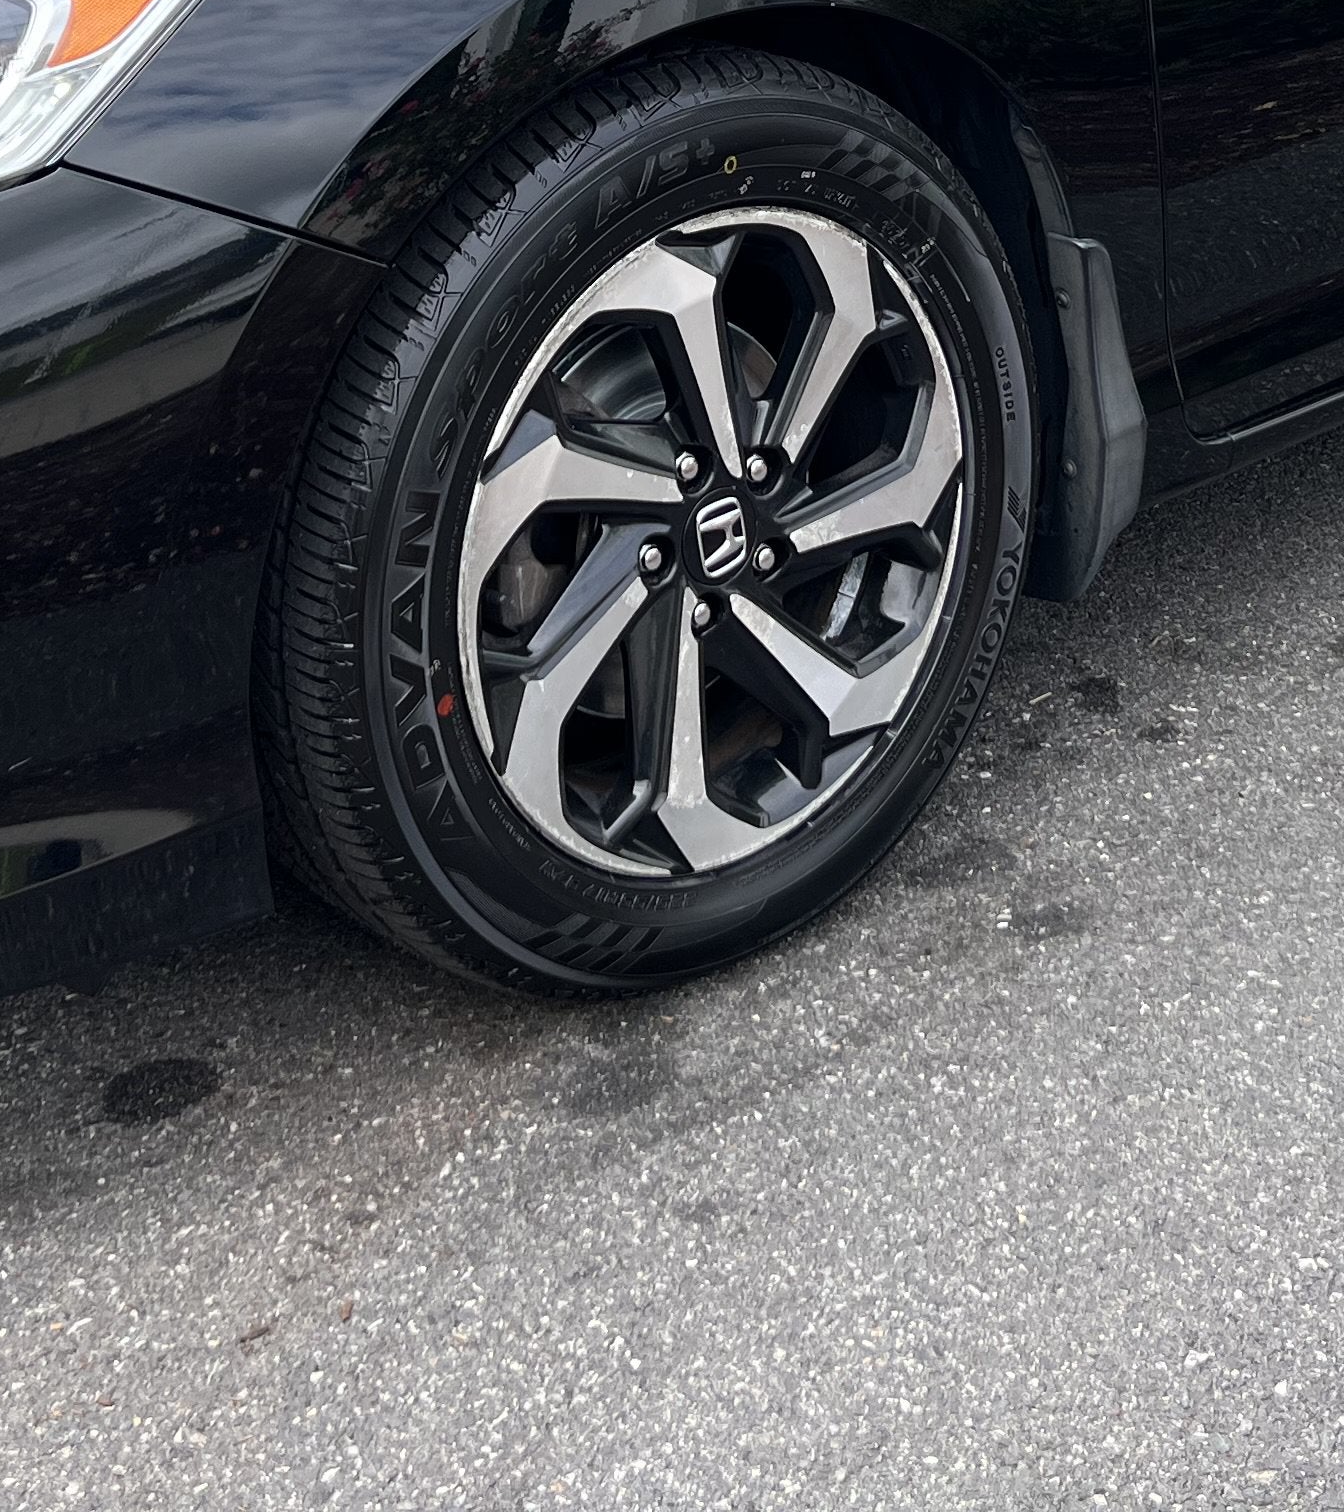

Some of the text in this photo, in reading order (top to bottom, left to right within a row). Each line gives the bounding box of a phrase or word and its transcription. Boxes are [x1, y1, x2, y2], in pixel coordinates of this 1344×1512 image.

[995, 346, 1016, 423] OUTSIDE
[389, 491, 476, 841] ADVAN
[920, 541, 1024, 771] YOKOHAMA
